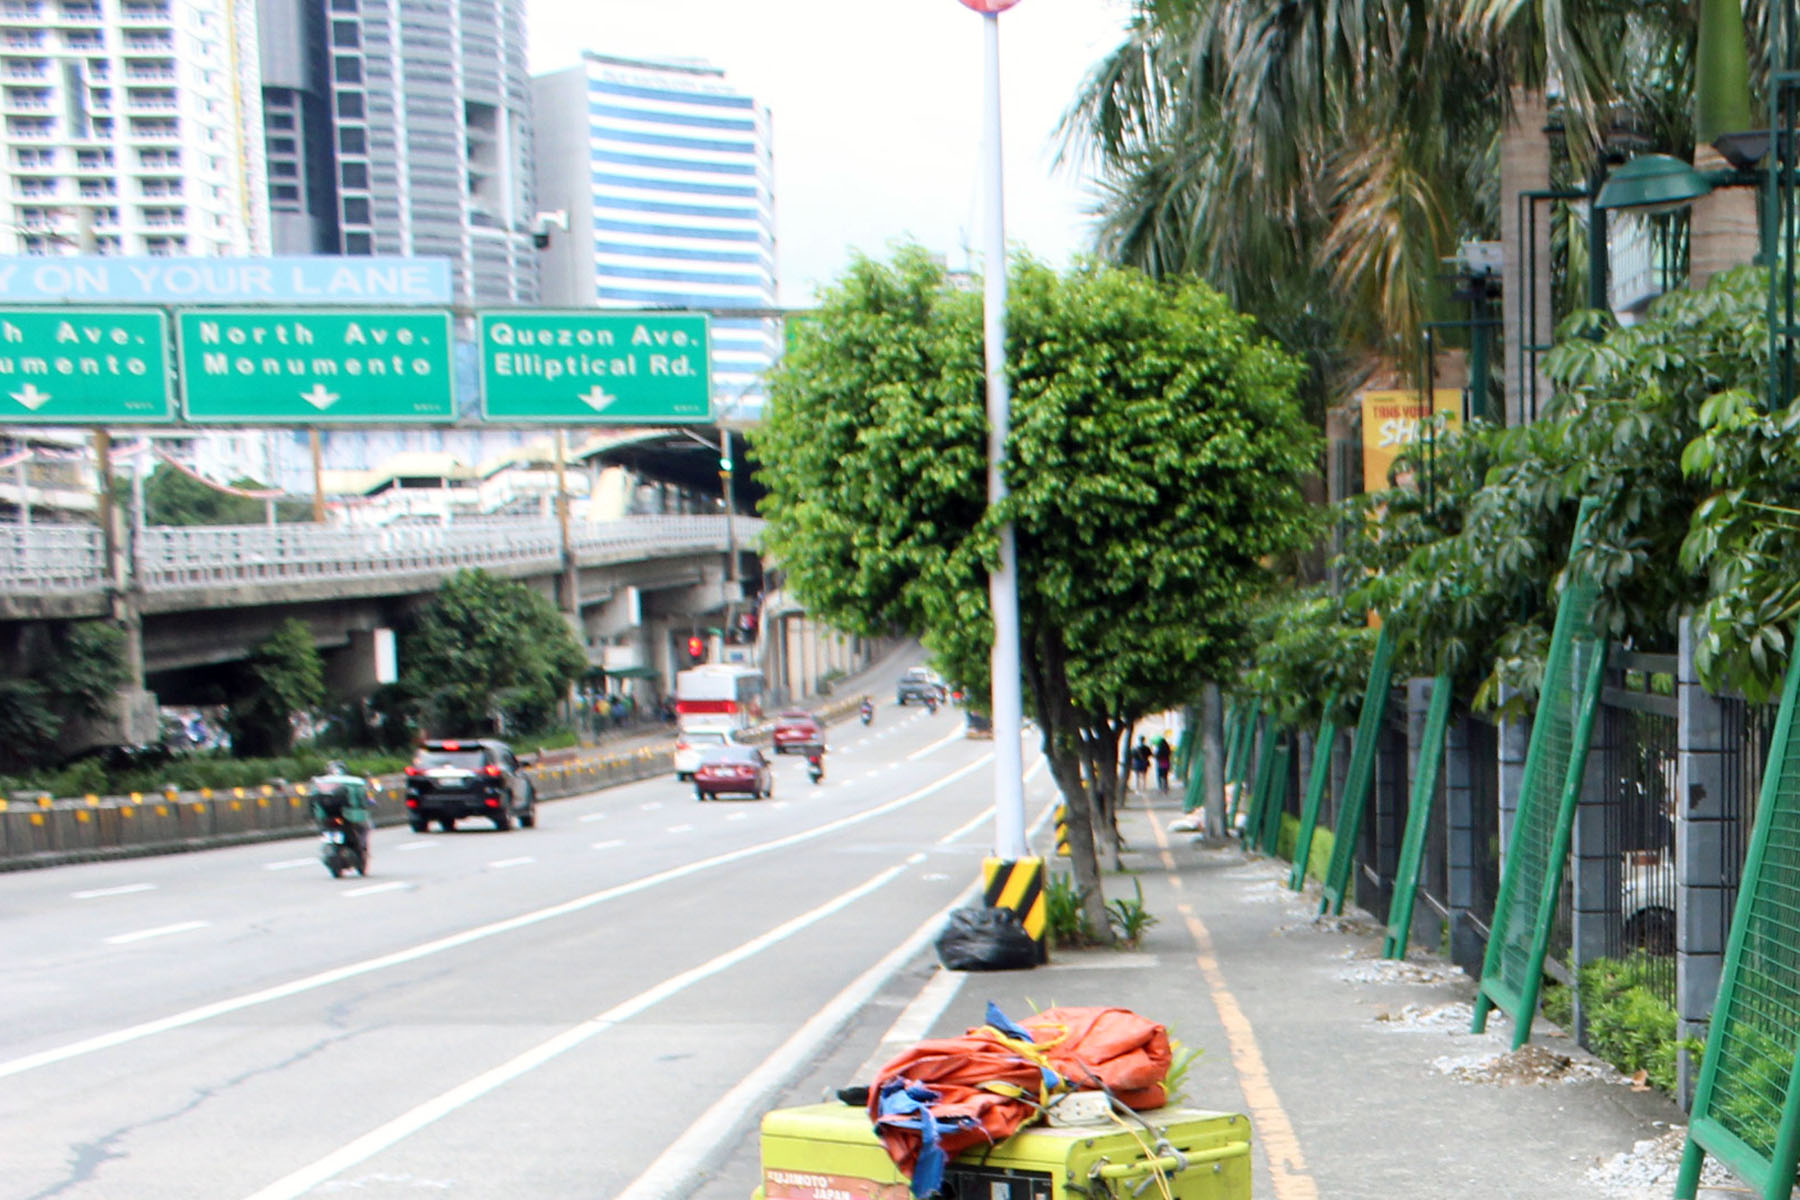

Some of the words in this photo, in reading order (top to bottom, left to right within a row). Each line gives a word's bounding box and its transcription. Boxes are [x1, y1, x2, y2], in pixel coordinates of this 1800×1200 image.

[34, 265, 109, 294] ON
[128, 265, 274, 294] YOUR
[291, 265, 433, 296] LANE
[56, 320, 145, 345] Ave.
[200, 321, 313, 345] North
[344, 322, 430, 345] Ave.
[490, 323, 614, 347] Quezon
[631, 325, 698, 347] Ave.
[203, 353, 431, 376] Monumento
[494, 353, 637, 381] Elliptical
[648, 354, 697, 377] Rd.
